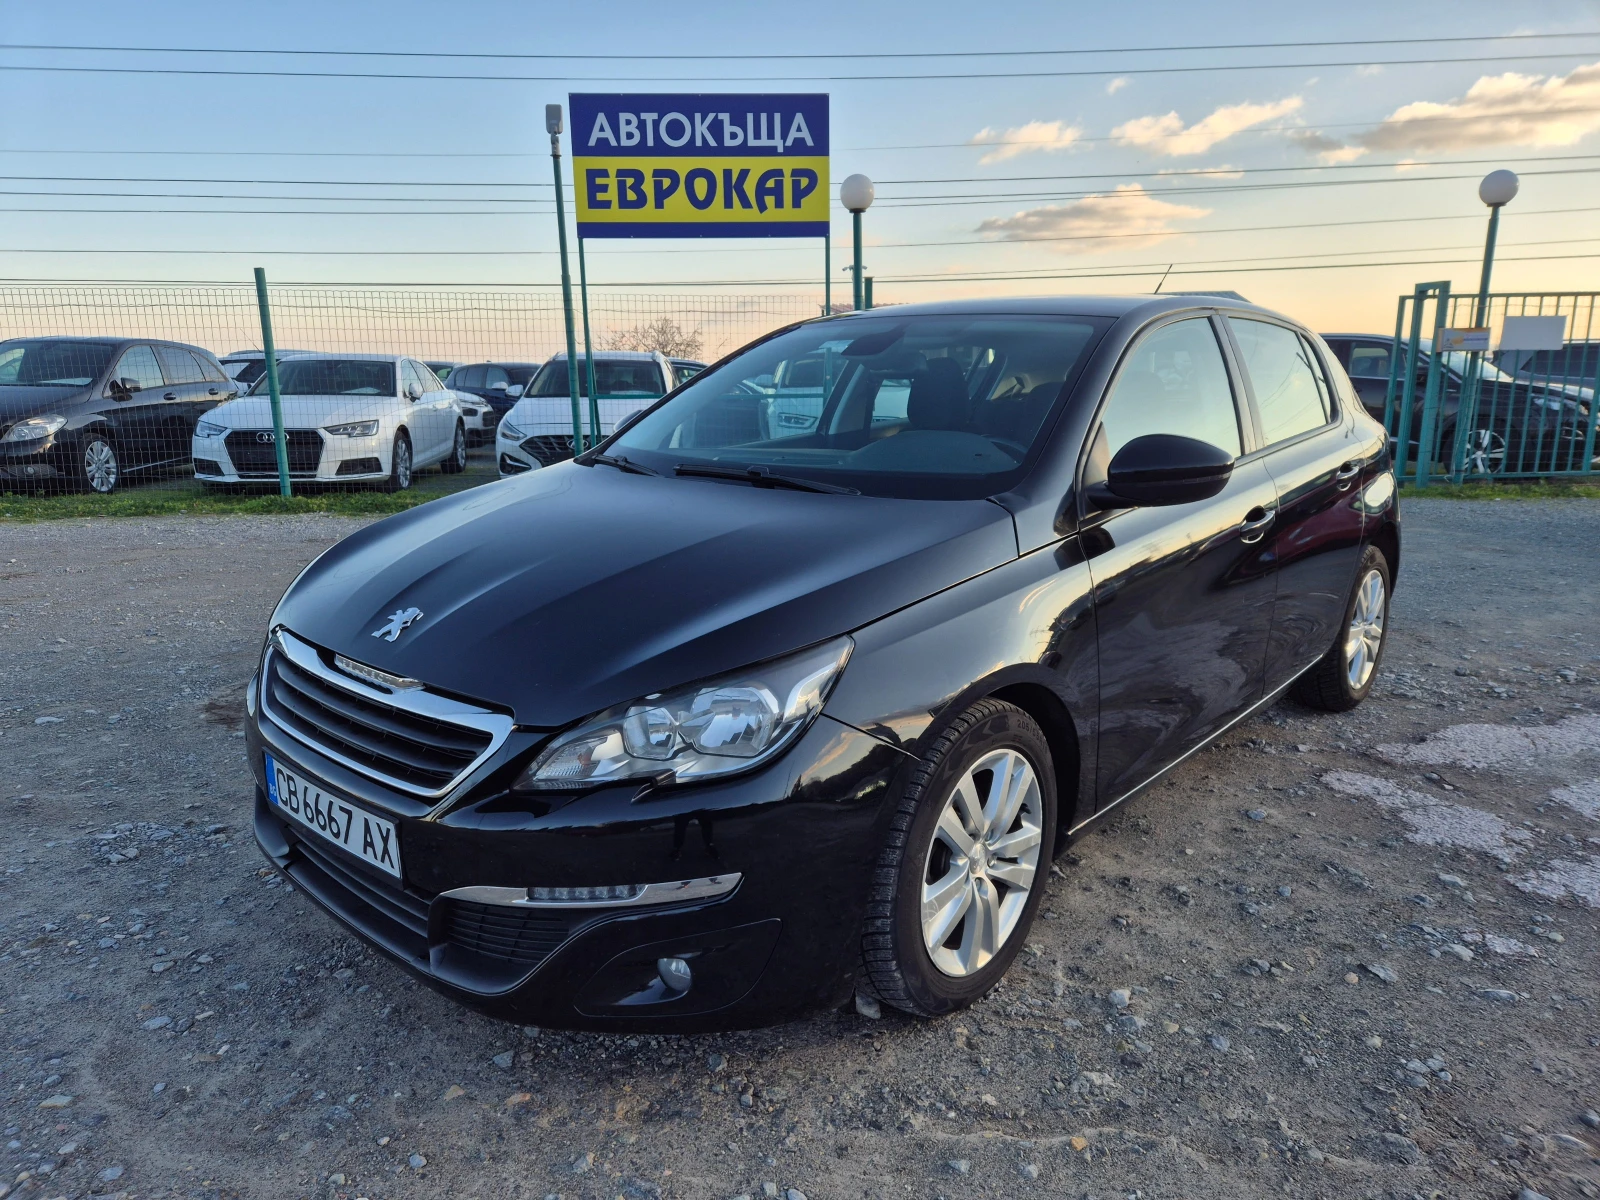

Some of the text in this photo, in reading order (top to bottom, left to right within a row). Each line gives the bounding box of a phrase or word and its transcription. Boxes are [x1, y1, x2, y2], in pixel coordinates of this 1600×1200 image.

[588, 112, 814, 152] АВТОКЪЩА
[586, 168, 818, 214] ЕВРОКАР
[303, 785, 353, 845] 6667
[363, 817, 395, 870] AX
